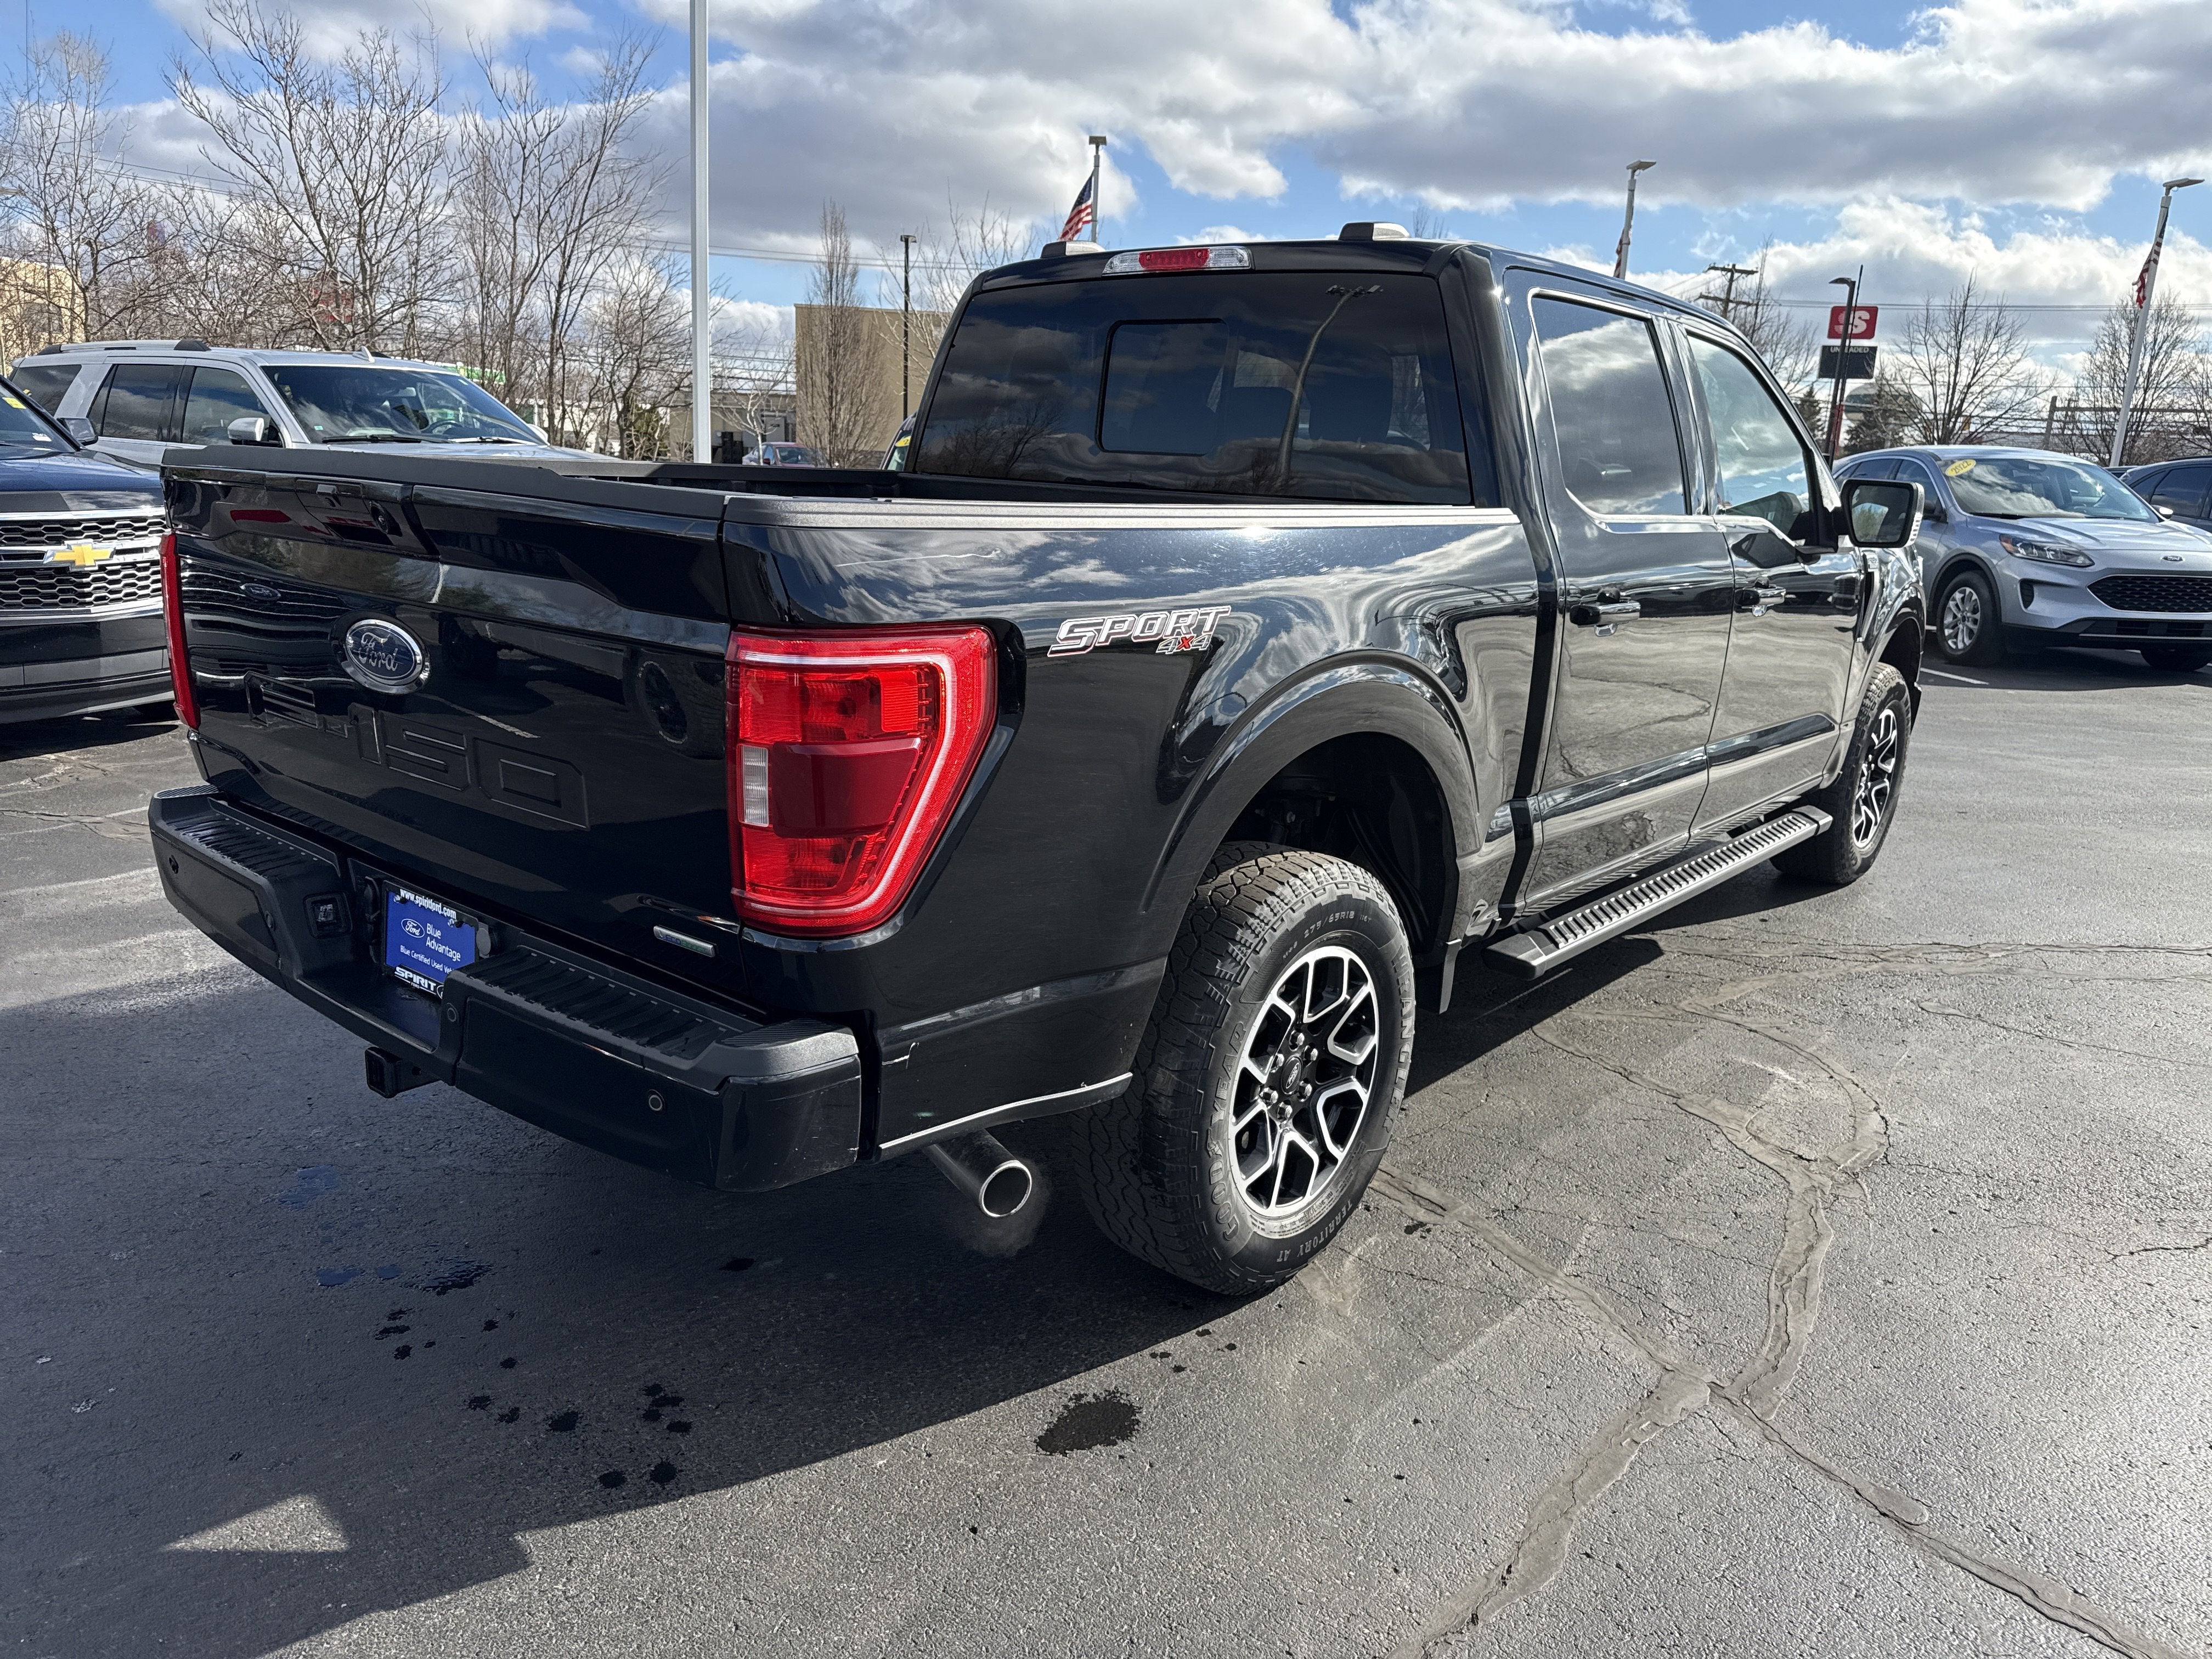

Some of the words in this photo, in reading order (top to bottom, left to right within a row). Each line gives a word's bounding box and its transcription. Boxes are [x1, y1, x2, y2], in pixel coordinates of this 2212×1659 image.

[1951, 461, 1972, 473] 2022
[1047, 605, 1231, 657] SPORT
[354, 632, 404, 672] Ford
[400, 889, 456, 919] www.spiritford.com
[405, 921, 420, 936] Ford
[427, 923, 441, 939] Blue
[400, 945, 410, 956] Blue
[411, 950, 430, 965] Certified
[431, 959, 443, 971] Used
[426, 936, 461, 962] Advantage
[394, 966, 436, 991] SPIRIT
[1383, 945, 1415, 1133] WRANGLER
[1297, 1199, 1353, 1257] TERRITORY
[1277, 1249, 1291, 1262] AT
